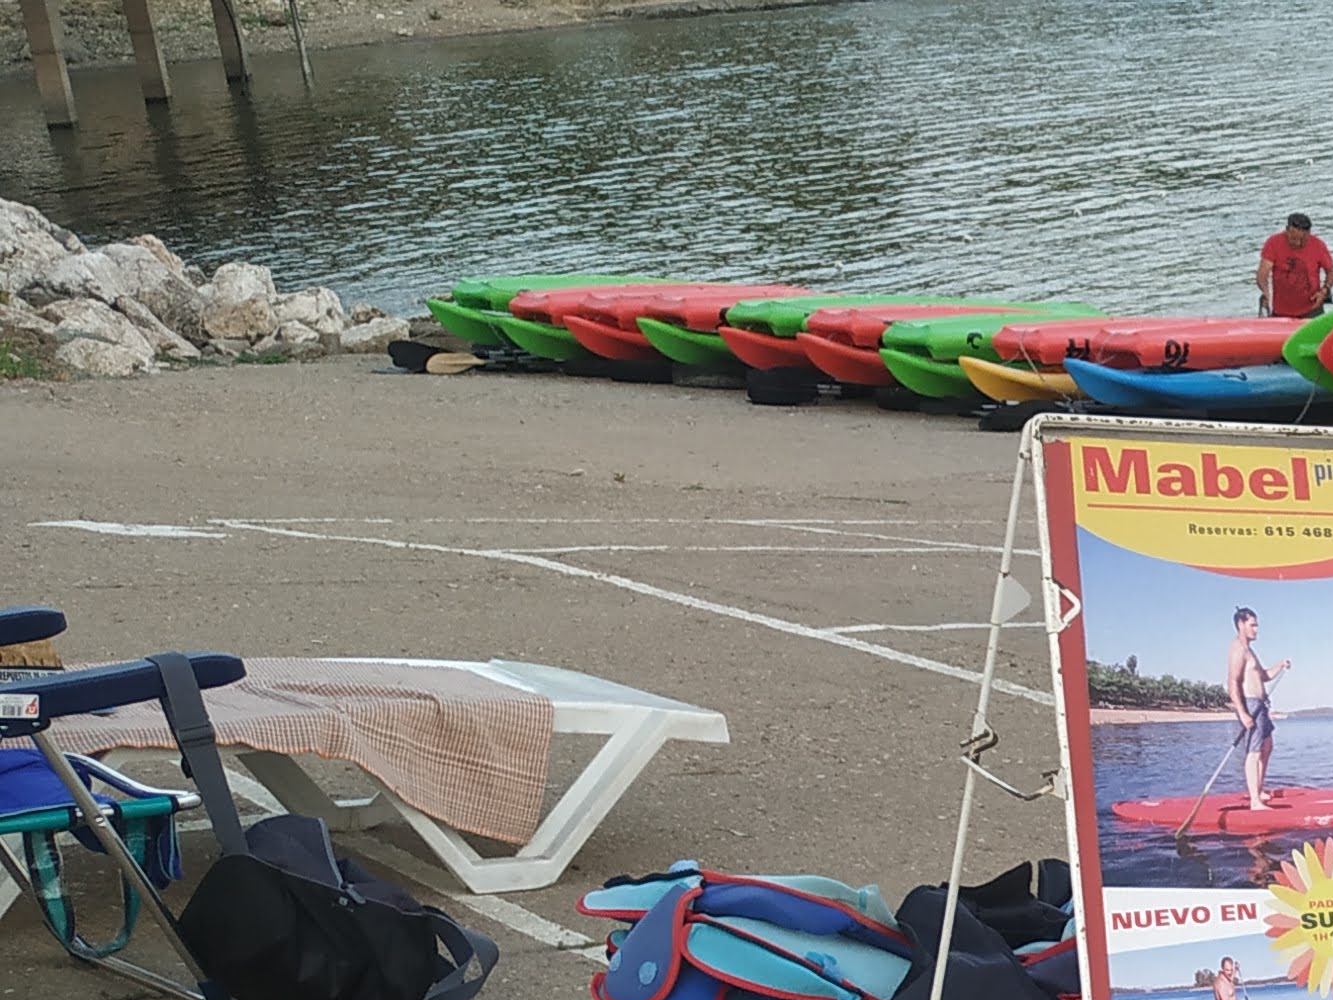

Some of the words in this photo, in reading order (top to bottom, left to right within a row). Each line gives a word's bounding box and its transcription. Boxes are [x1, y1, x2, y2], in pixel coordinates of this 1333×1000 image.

[1082, 446, 1310, 501] Mabel
[1189, 523, 1258, 536] Reservas:
[1264, 526, 1295, 537] 615
[1302, 527, 1333, 538] 468
[1111, 905, 1211, 930] NUEVO
[1220, 903, 1257, 921] EN
[1313, 933, 1328, 941] 1H
